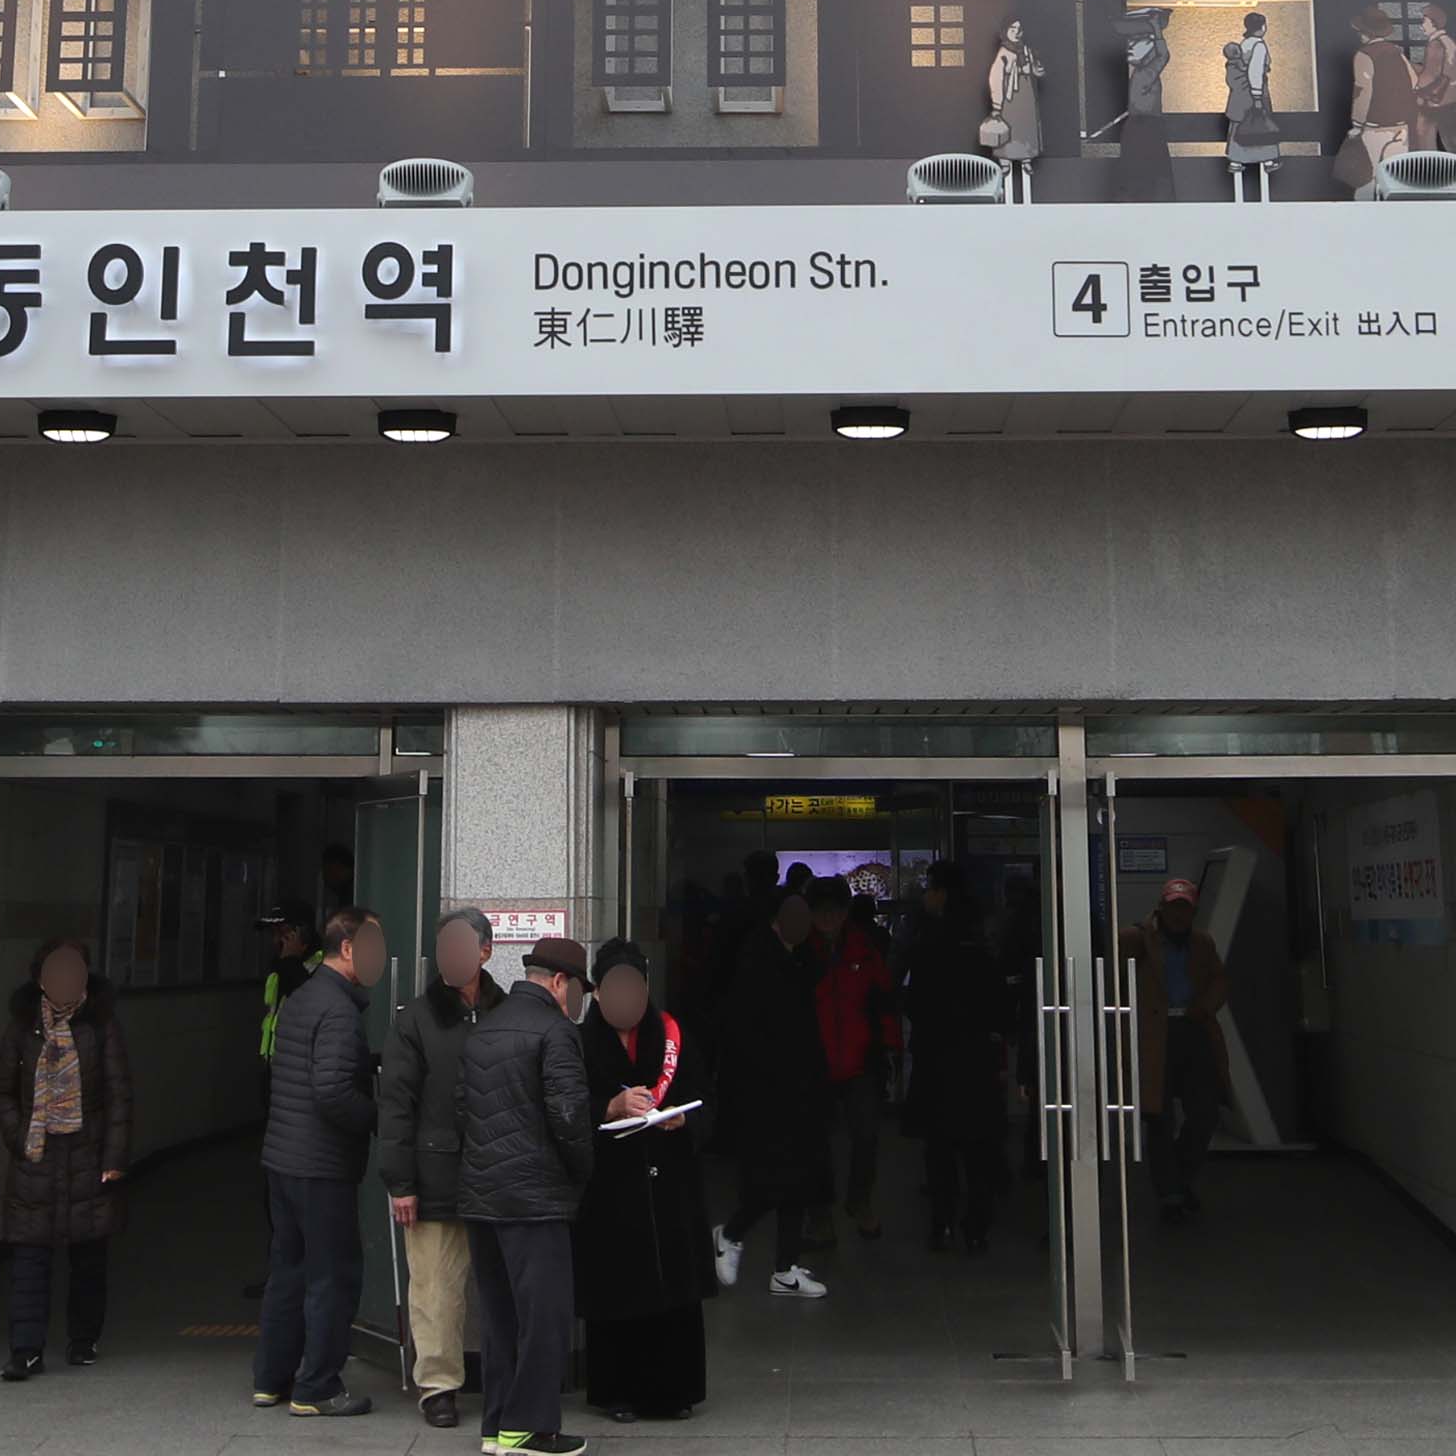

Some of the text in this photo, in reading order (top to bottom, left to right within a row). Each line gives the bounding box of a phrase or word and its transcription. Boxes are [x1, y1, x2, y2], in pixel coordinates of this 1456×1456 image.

[534, 251, 889, 299] Dongincheon Stn.
[1138, 263, 1261, 303] 출입구
[1071, 273, 1108, 324] 4
[533, 306, 705, 350] 東仁川驛
[1143, 308, 1437, 341] Entrance/Exit 出入口
[489, 914, 556, 926] 금연구역
